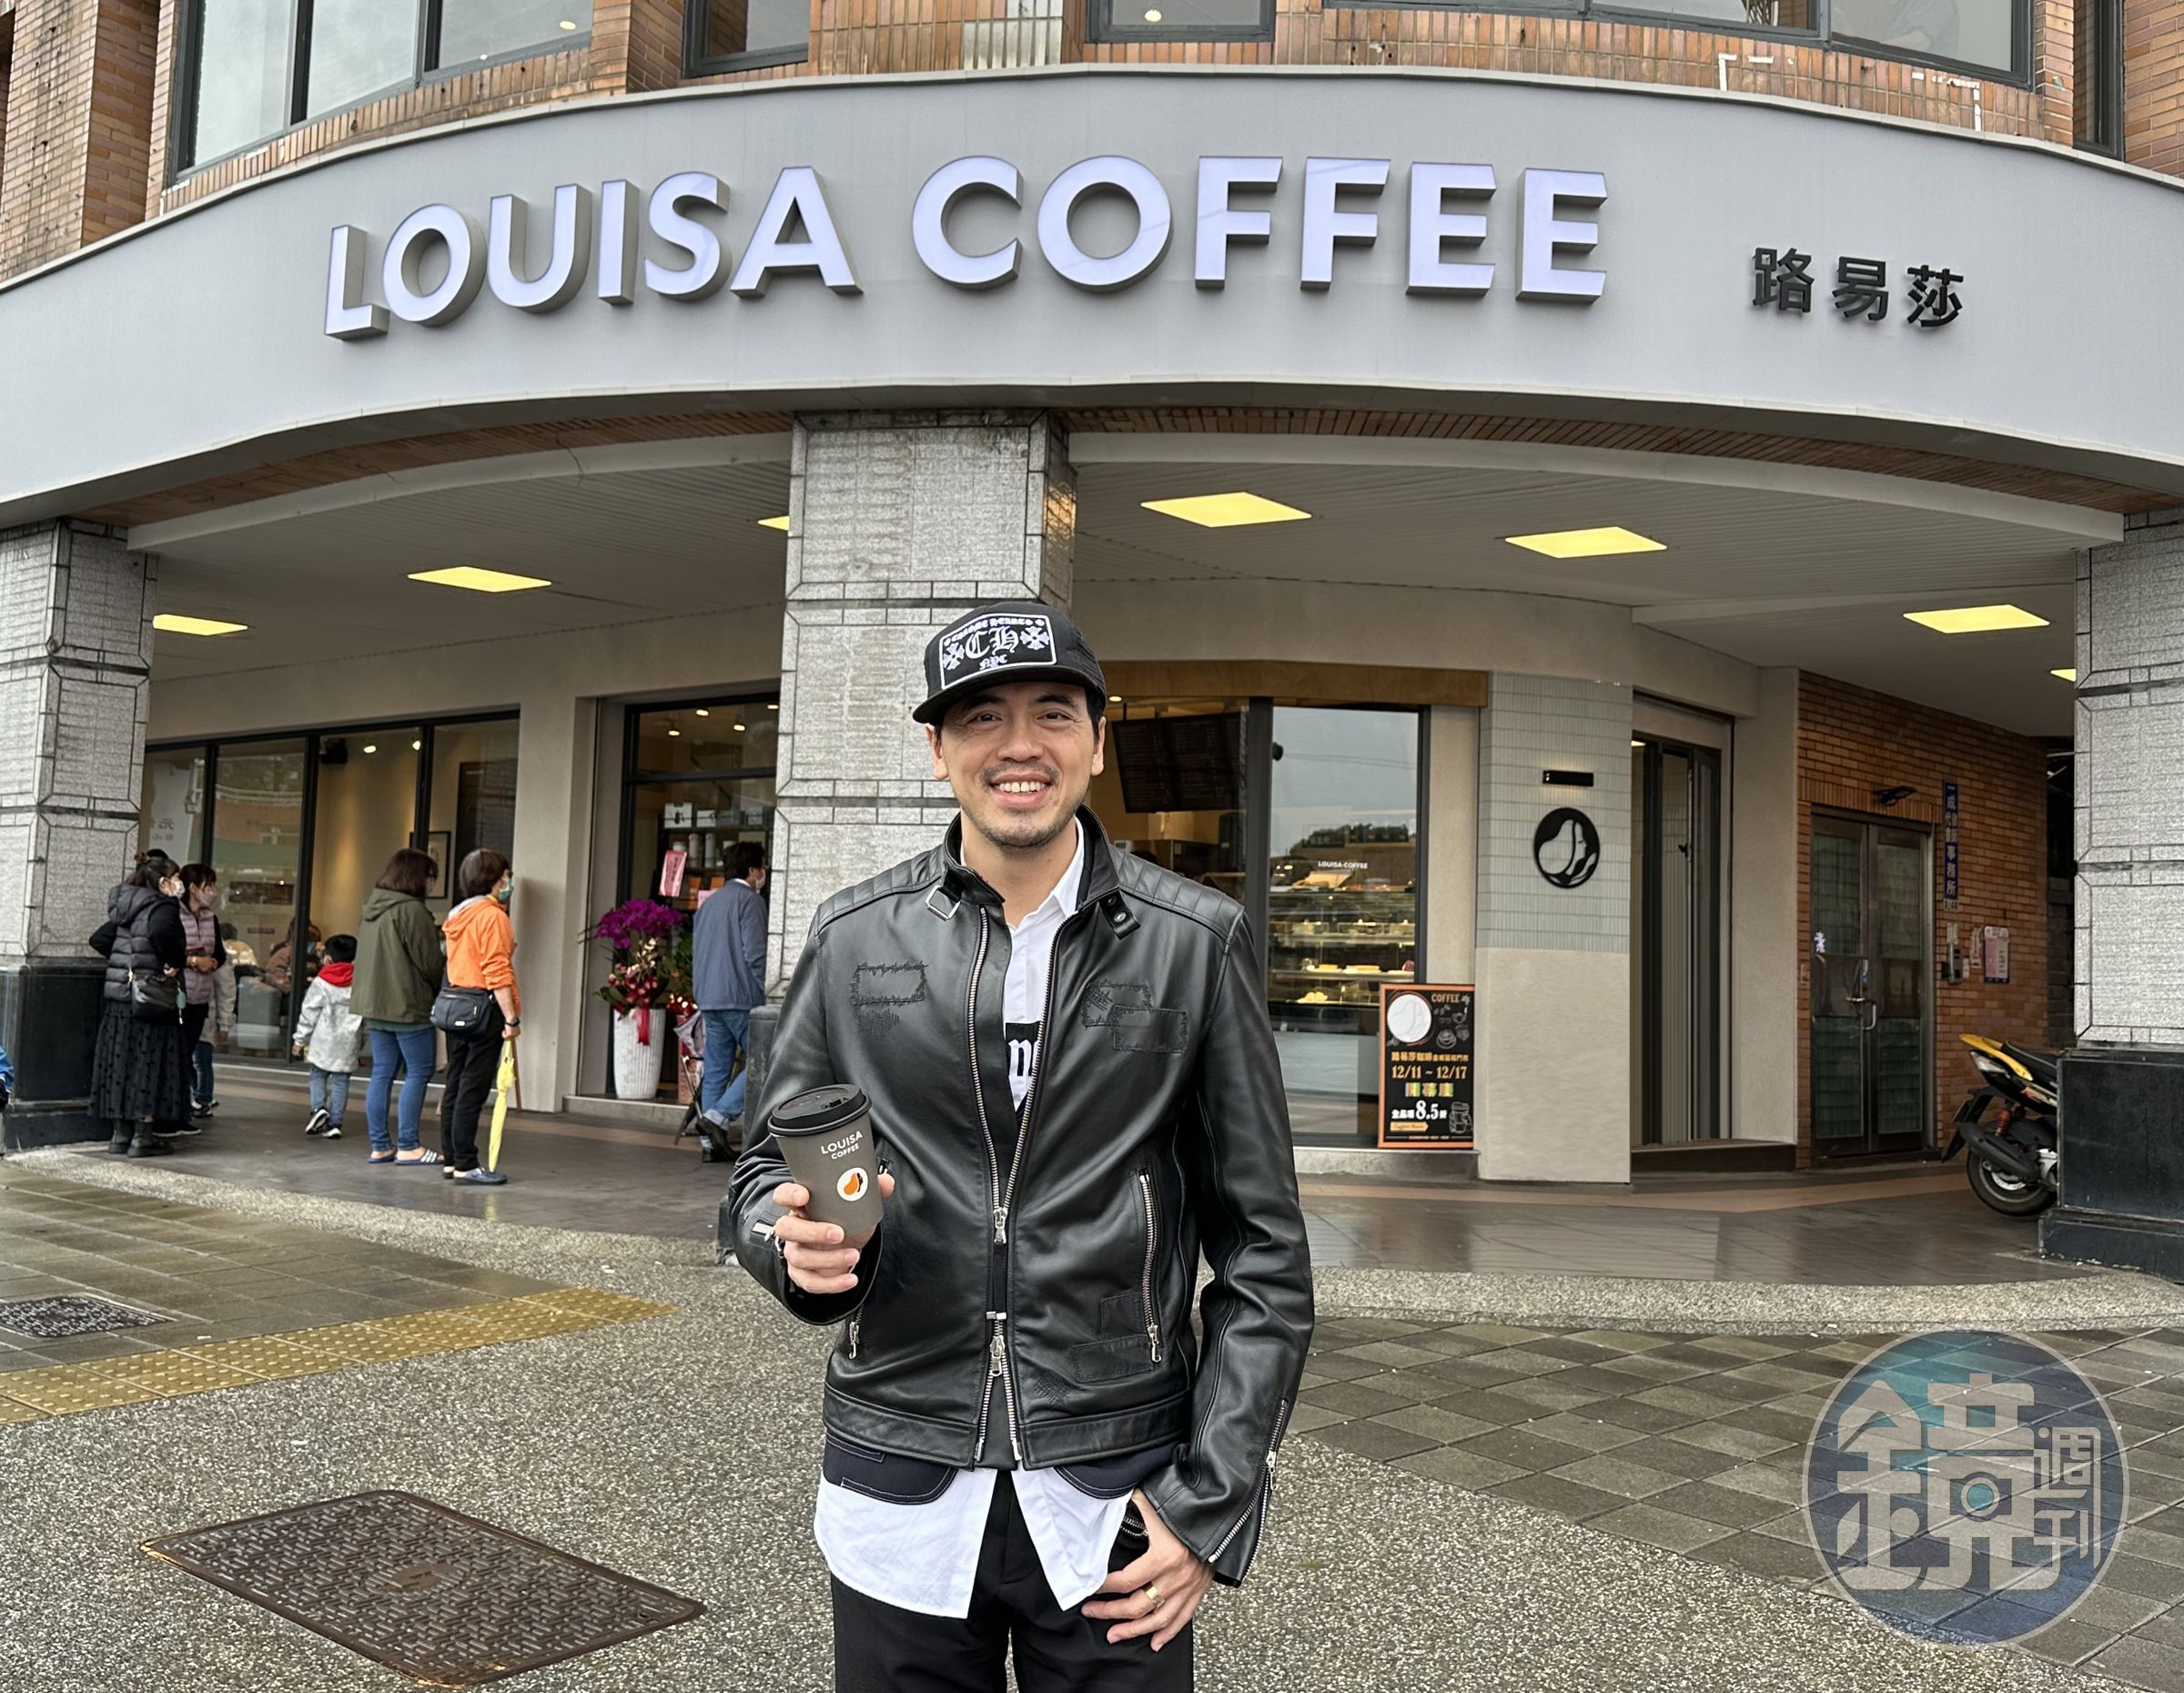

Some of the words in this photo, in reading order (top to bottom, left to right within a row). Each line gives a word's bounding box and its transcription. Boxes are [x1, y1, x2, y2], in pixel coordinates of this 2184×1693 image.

[324, 166, 864, 341] LOUISA
[912, 154, 1609, 304] COFFEE
[1753, 247, 1964, 328] 路易莎
[965, 625, 1019, 659] CH
[1343, 861, 1368, 869] COFFEE
[1431, 993, 1461, 1003] COFFEE
[1391, 1065, 1421, 1079] 12/11
[1436, 1066, 1467, 1080] 12/17
[820, 1130, 864, 1154] LOUISA
[831, 1142, 860, 1160] COFFEE
